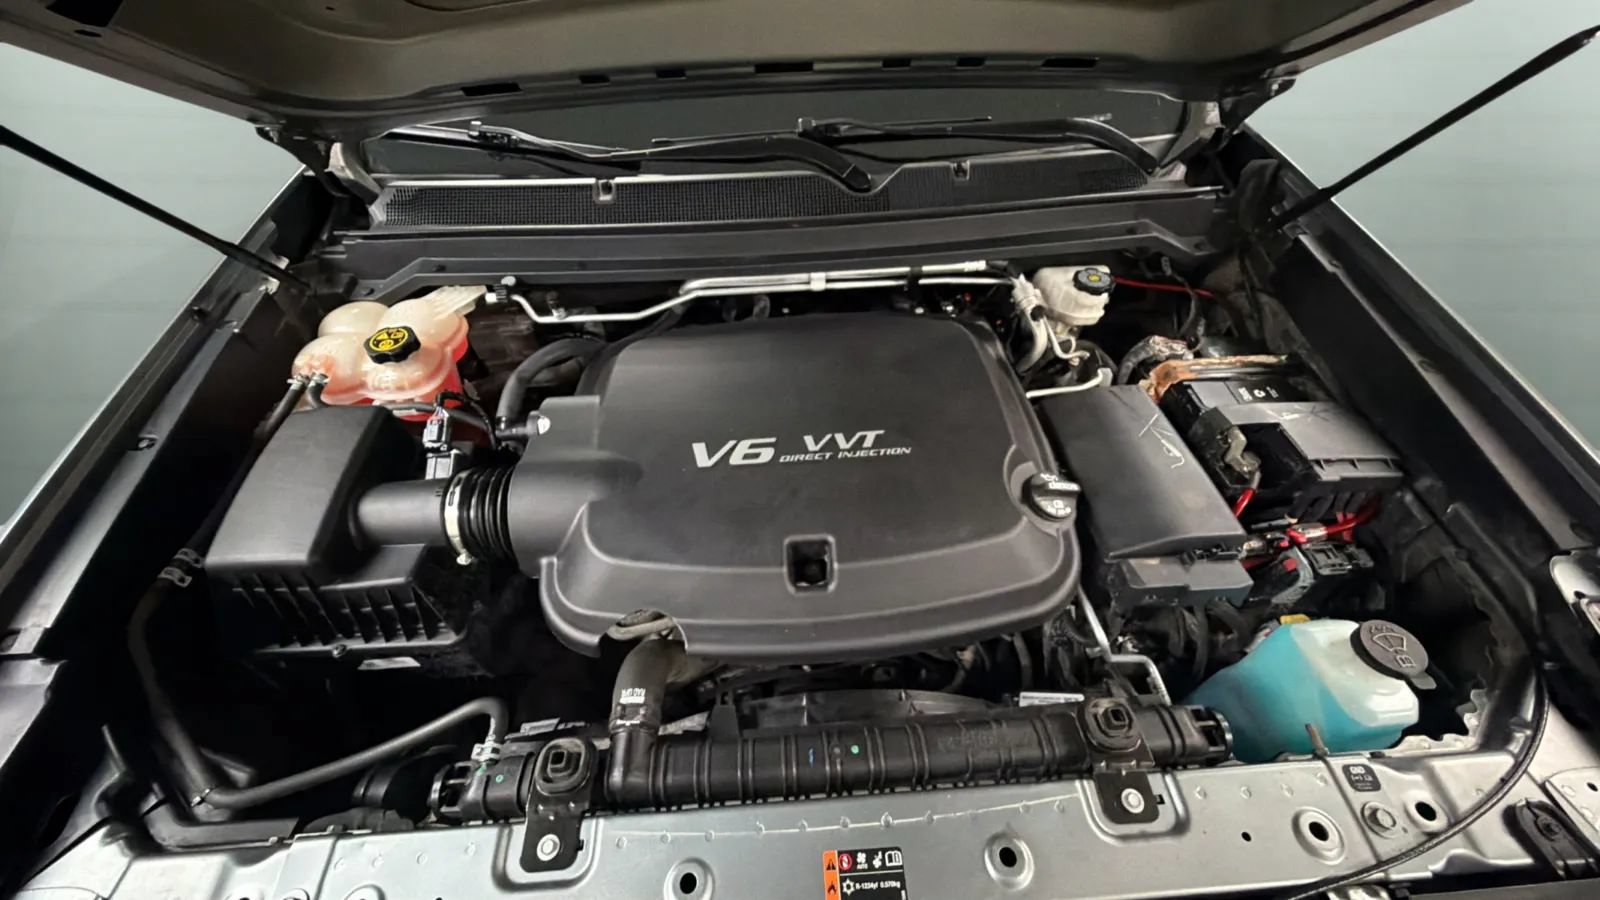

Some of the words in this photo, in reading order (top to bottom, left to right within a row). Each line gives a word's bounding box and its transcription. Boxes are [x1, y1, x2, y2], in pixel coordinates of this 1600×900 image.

[691, 437, 777, 468] V6
[803, 429, 885, 452] VVT
[779, 452, 833, 463] DIRECT
[837, 447, 912, 459] INJECTION
